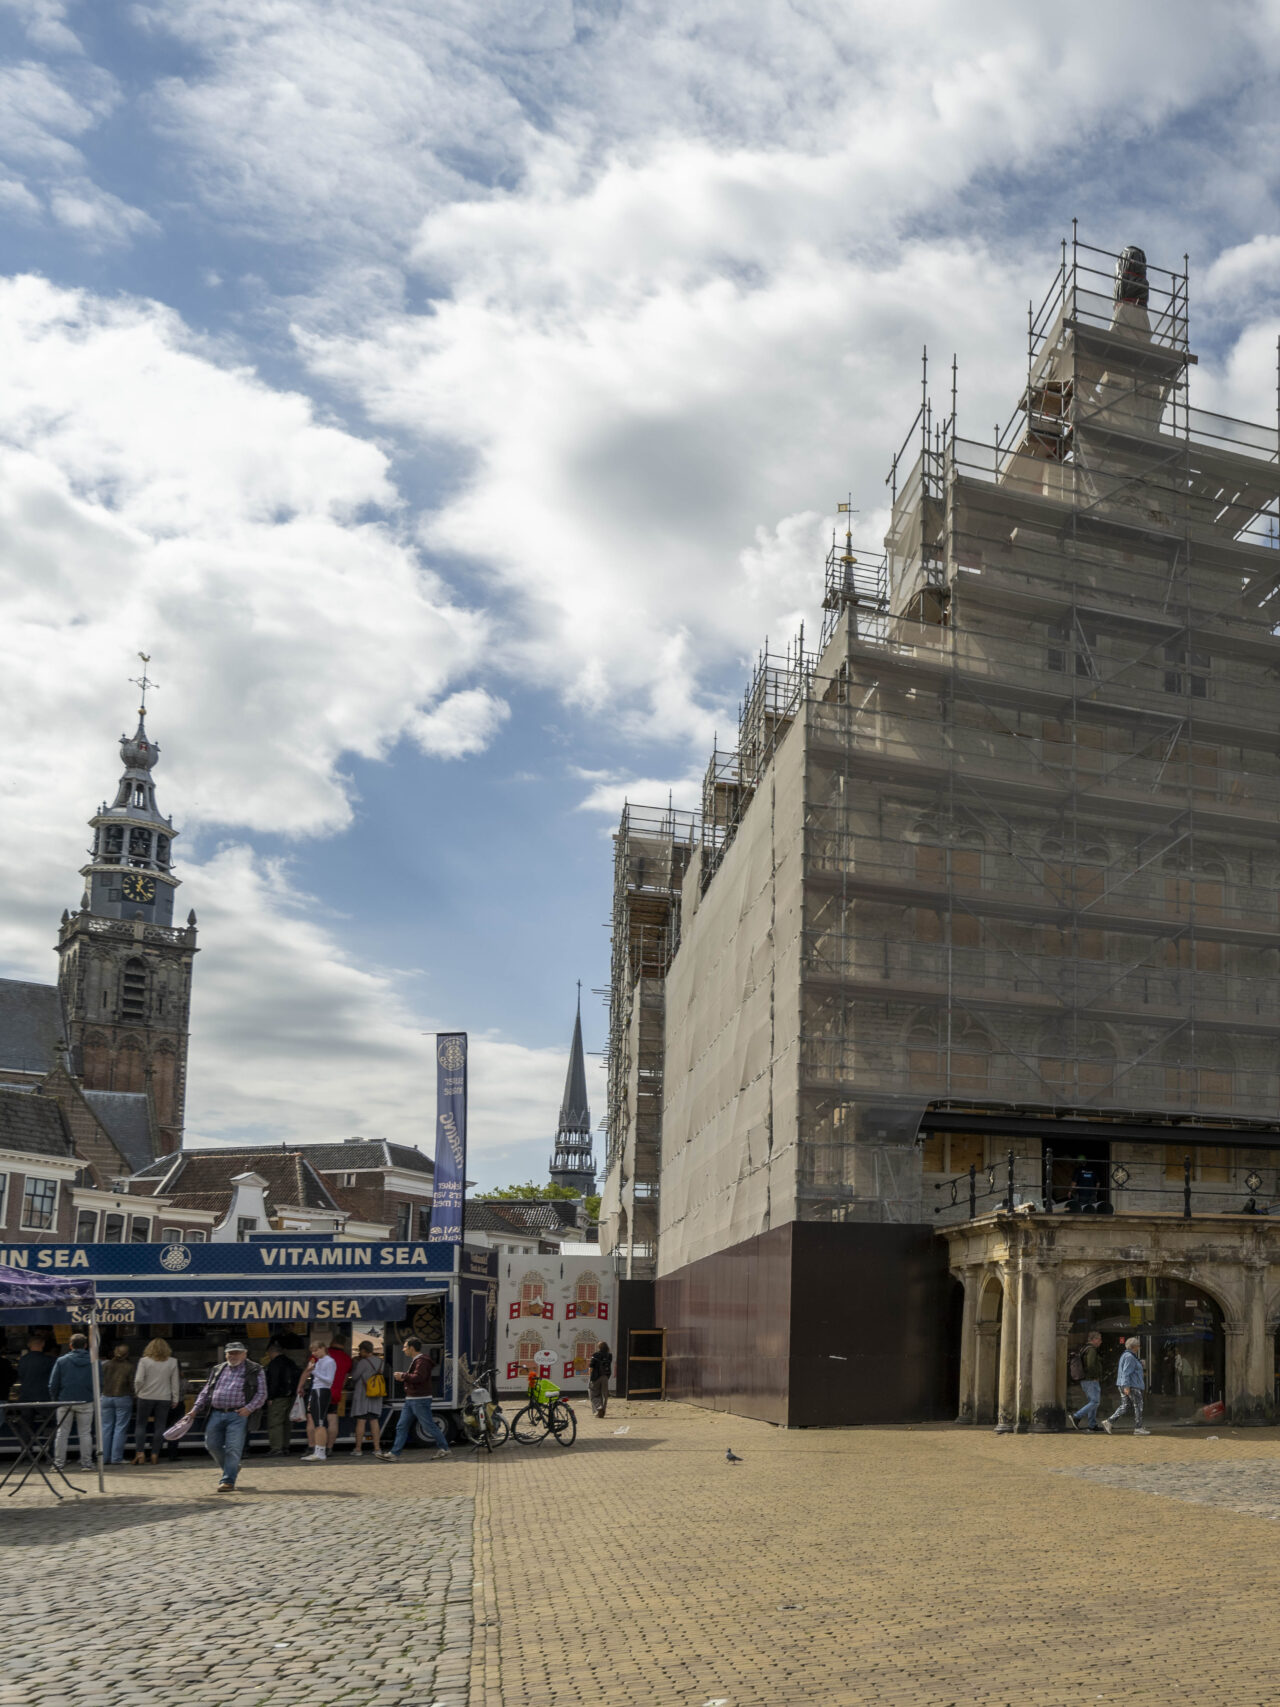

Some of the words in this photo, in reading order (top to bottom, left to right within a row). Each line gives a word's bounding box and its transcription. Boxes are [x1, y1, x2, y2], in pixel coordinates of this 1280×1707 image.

[37, 1250, 90, 1268] SEA
[260, 1248, 372, 1266] VITAMIN
[379, 1247, 428, 1265] SEA
[203, 1301, 310, 1320] VITAMIN
[316, 1300, 362, 1319] SEA
